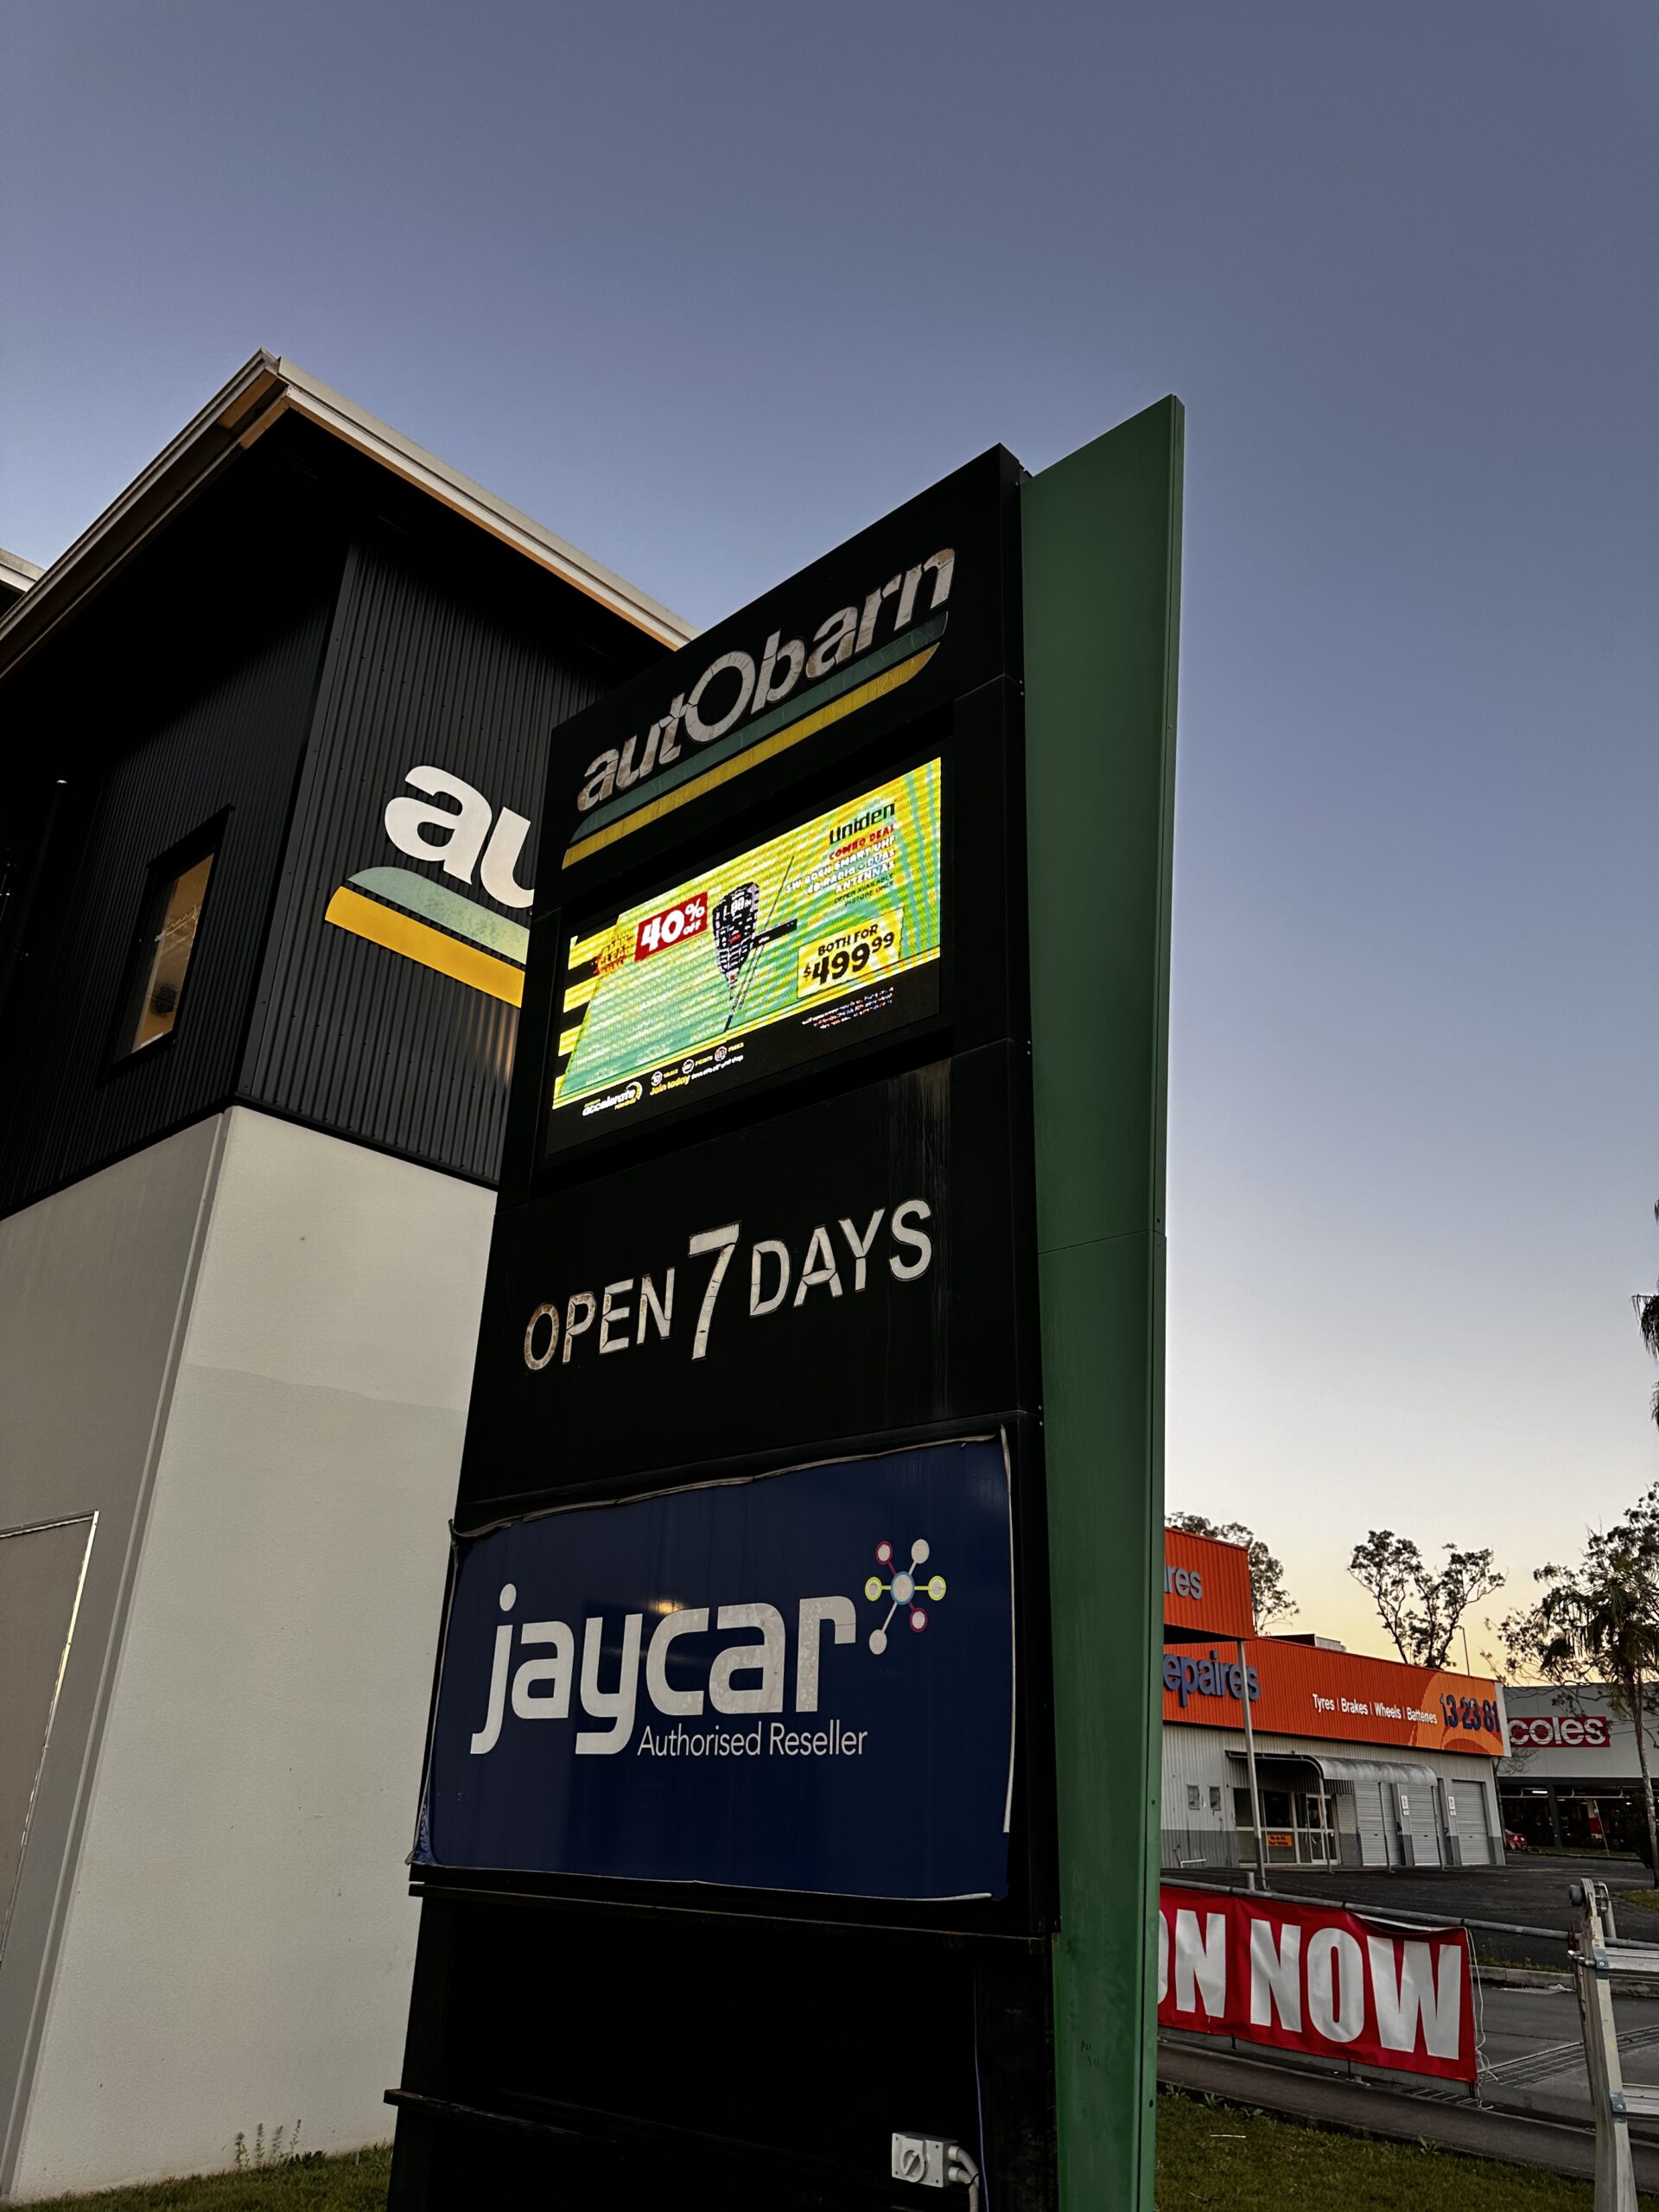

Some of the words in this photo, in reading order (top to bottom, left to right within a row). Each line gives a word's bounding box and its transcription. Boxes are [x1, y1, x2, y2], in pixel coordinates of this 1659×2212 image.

[834, 846, 872, 871] SMART
[836, 861, 895, 894] ANTENNAS
[683, 920, 701, 935] OFF
[818, 936, 851, 957] BOTH
[854, 924, 879, 944] FOR
[667, 1074, 691, 1089] today
[524, 1266, 676, 1371] OPEN
[688, 1220, 742, 1361] 7
[749, 1198, 933, 1318] DAYS
[470, 1583, 856, 1755] jaycar
[1313, 1694, 1335, 1713] Tyres
[1341, 1698, 1369, 1715] Brakes
[1375, 1702, 1402, 1719] Wheels
[1407, 1707, 1438, 1725] Batteries
[637, 1721, 762, 1757] Authorised
[770, 1719, 868, 1756] Reseller
[1508, 1717, 1606, 1745] coles
[1158, 1909, 1226, 2018] N
[1250, 1918, 1462, 2060] NOW
